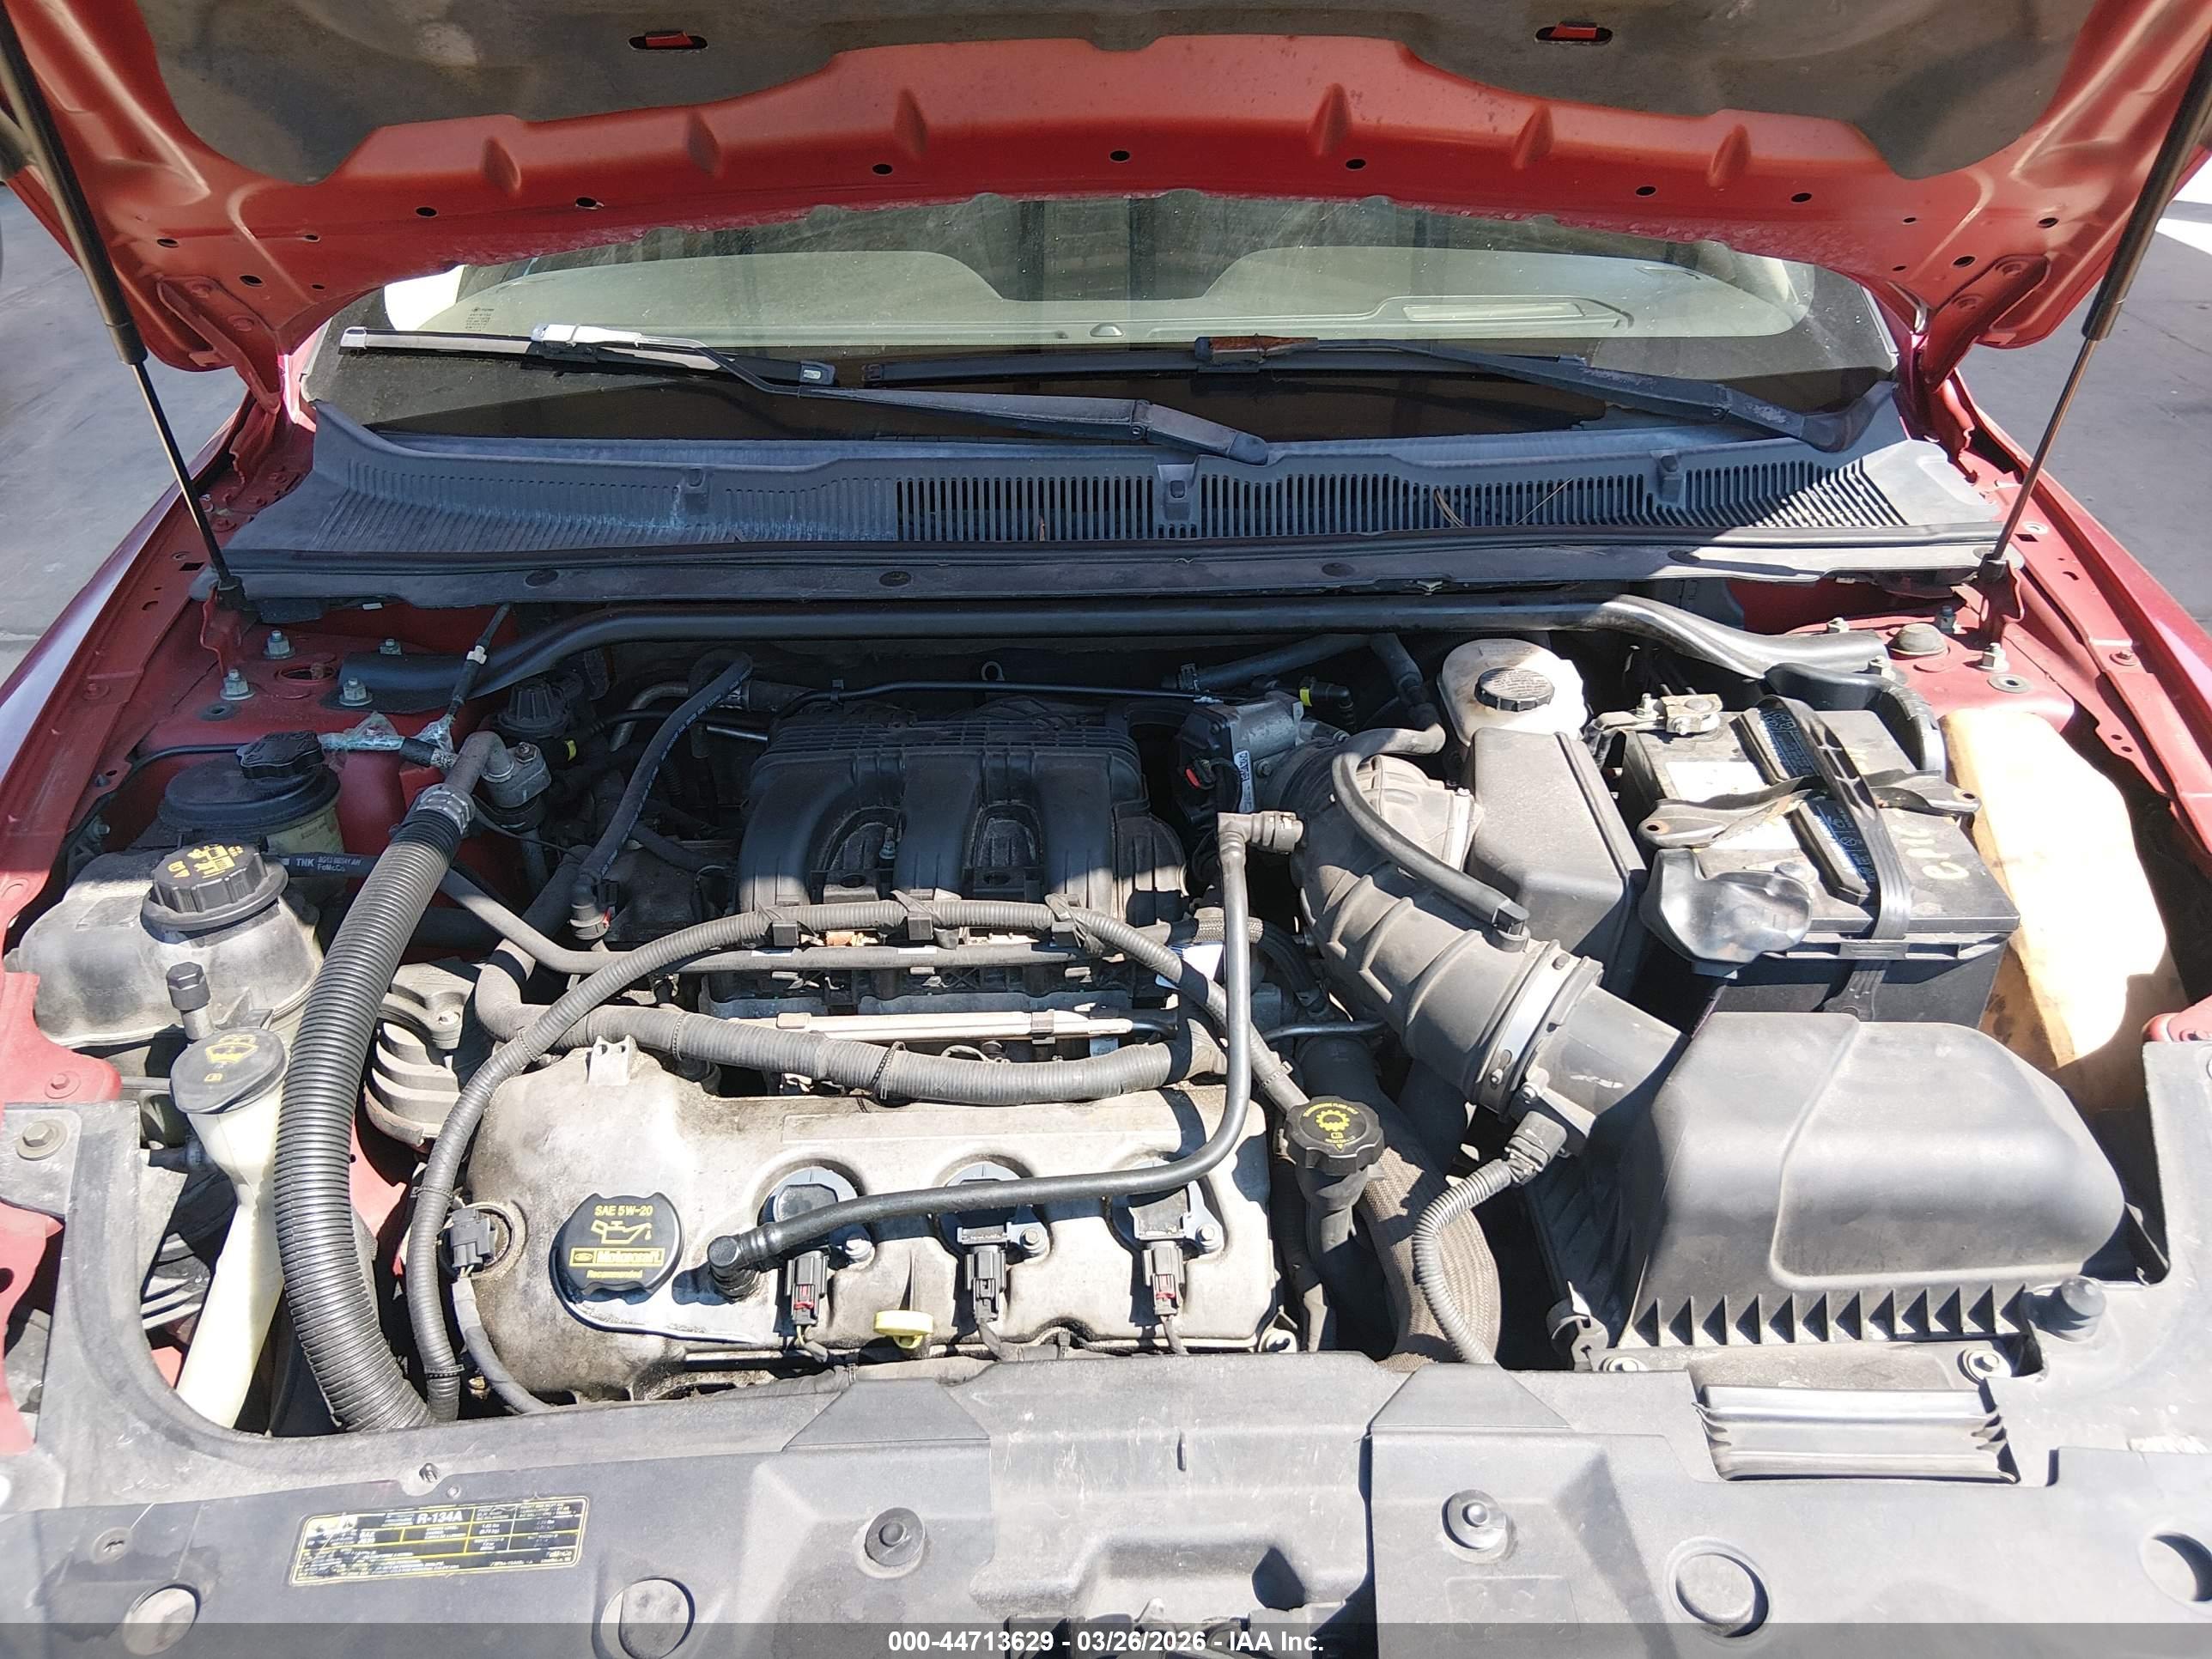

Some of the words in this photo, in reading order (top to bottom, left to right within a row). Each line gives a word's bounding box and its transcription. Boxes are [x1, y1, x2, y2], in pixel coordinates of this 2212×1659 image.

[295, 858, 315, 867] TNK
[594, 1205, 617, 1217] SAE
[617, 1205, 653, 1217] 5W-20
[416, 1510, 464, 1525] R-134A
